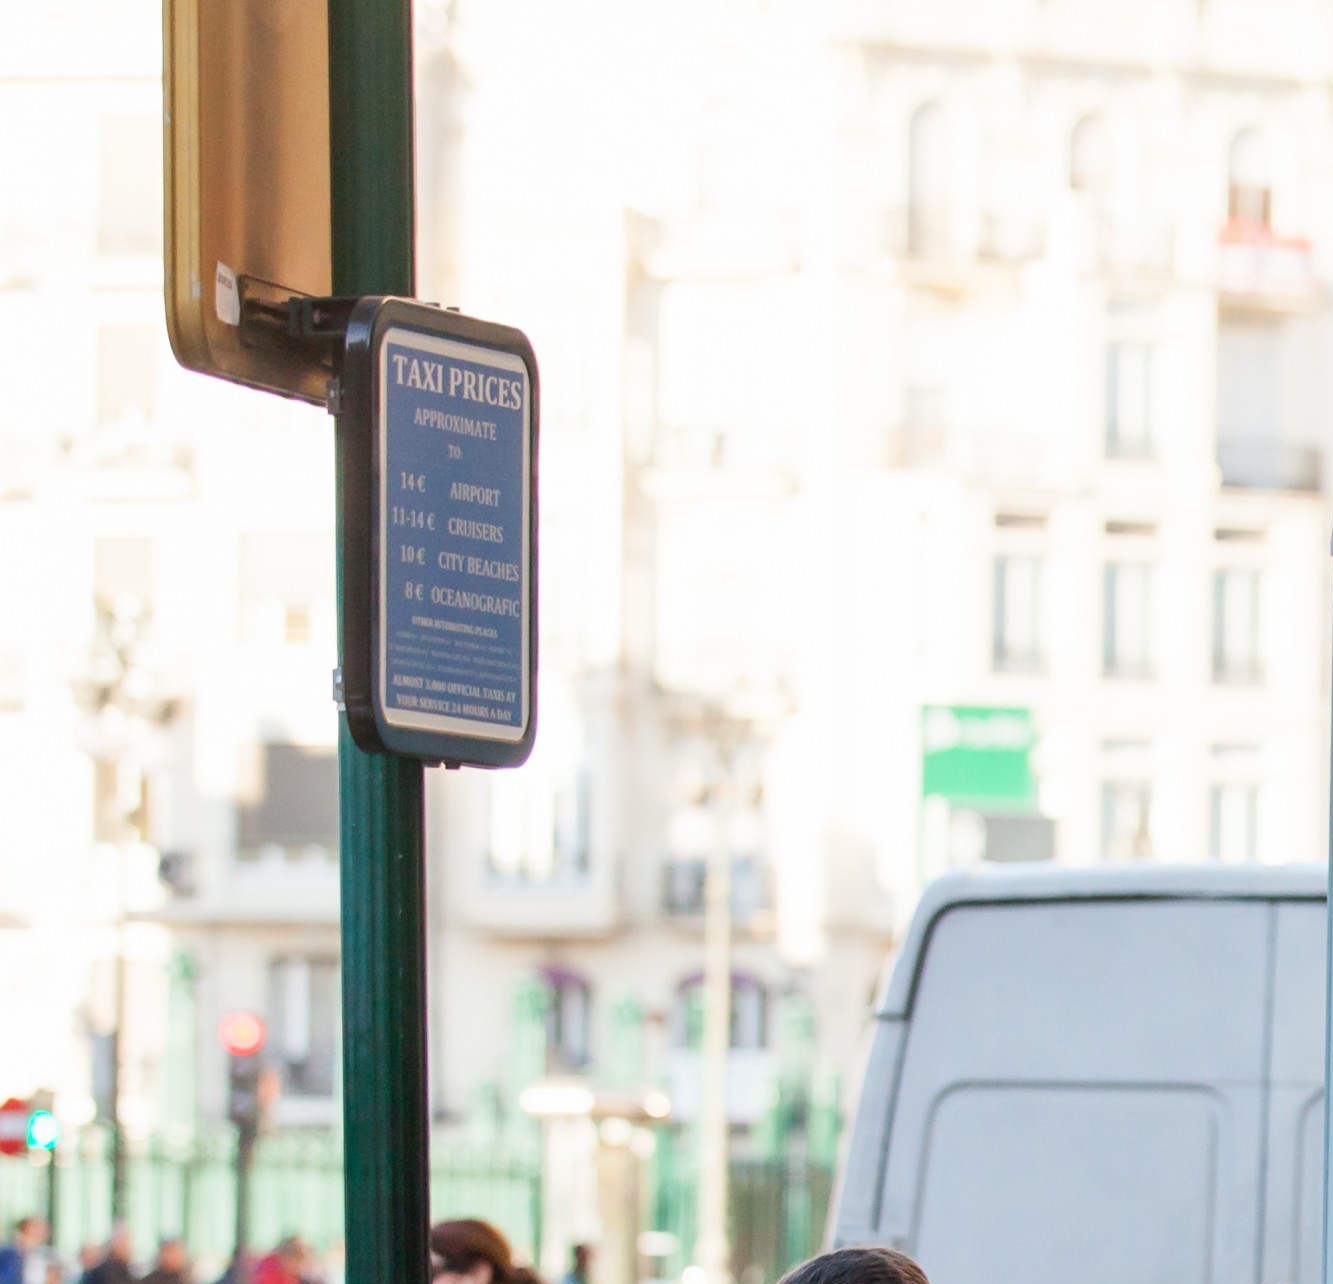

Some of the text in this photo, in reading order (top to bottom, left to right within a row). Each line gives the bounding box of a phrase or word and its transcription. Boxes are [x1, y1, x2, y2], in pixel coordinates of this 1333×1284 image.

[393, 355, 521, 410] TAXI PRICES
[414, 408, 497, 441] APPROXIMATE
[401, 471, 426, 493] 14 €
[450, 482, 501, 508] AIRPORT
[392, 506, 436, 531] 11-14 €
[448, 517, 504, 543] CRUISERS
[400, 545, 426, 565] 10 €
[438, 551, 520, 582] CITY BEACHES
[405, 581, 424, 601] 8 €
[431, 586, 521, 618] OCEANOGRAFIC
[392, 673, 424, 688] ALMOST
[419, 696, 450, 712] SERVICE
[462, 704, 488, 718] HOURS
